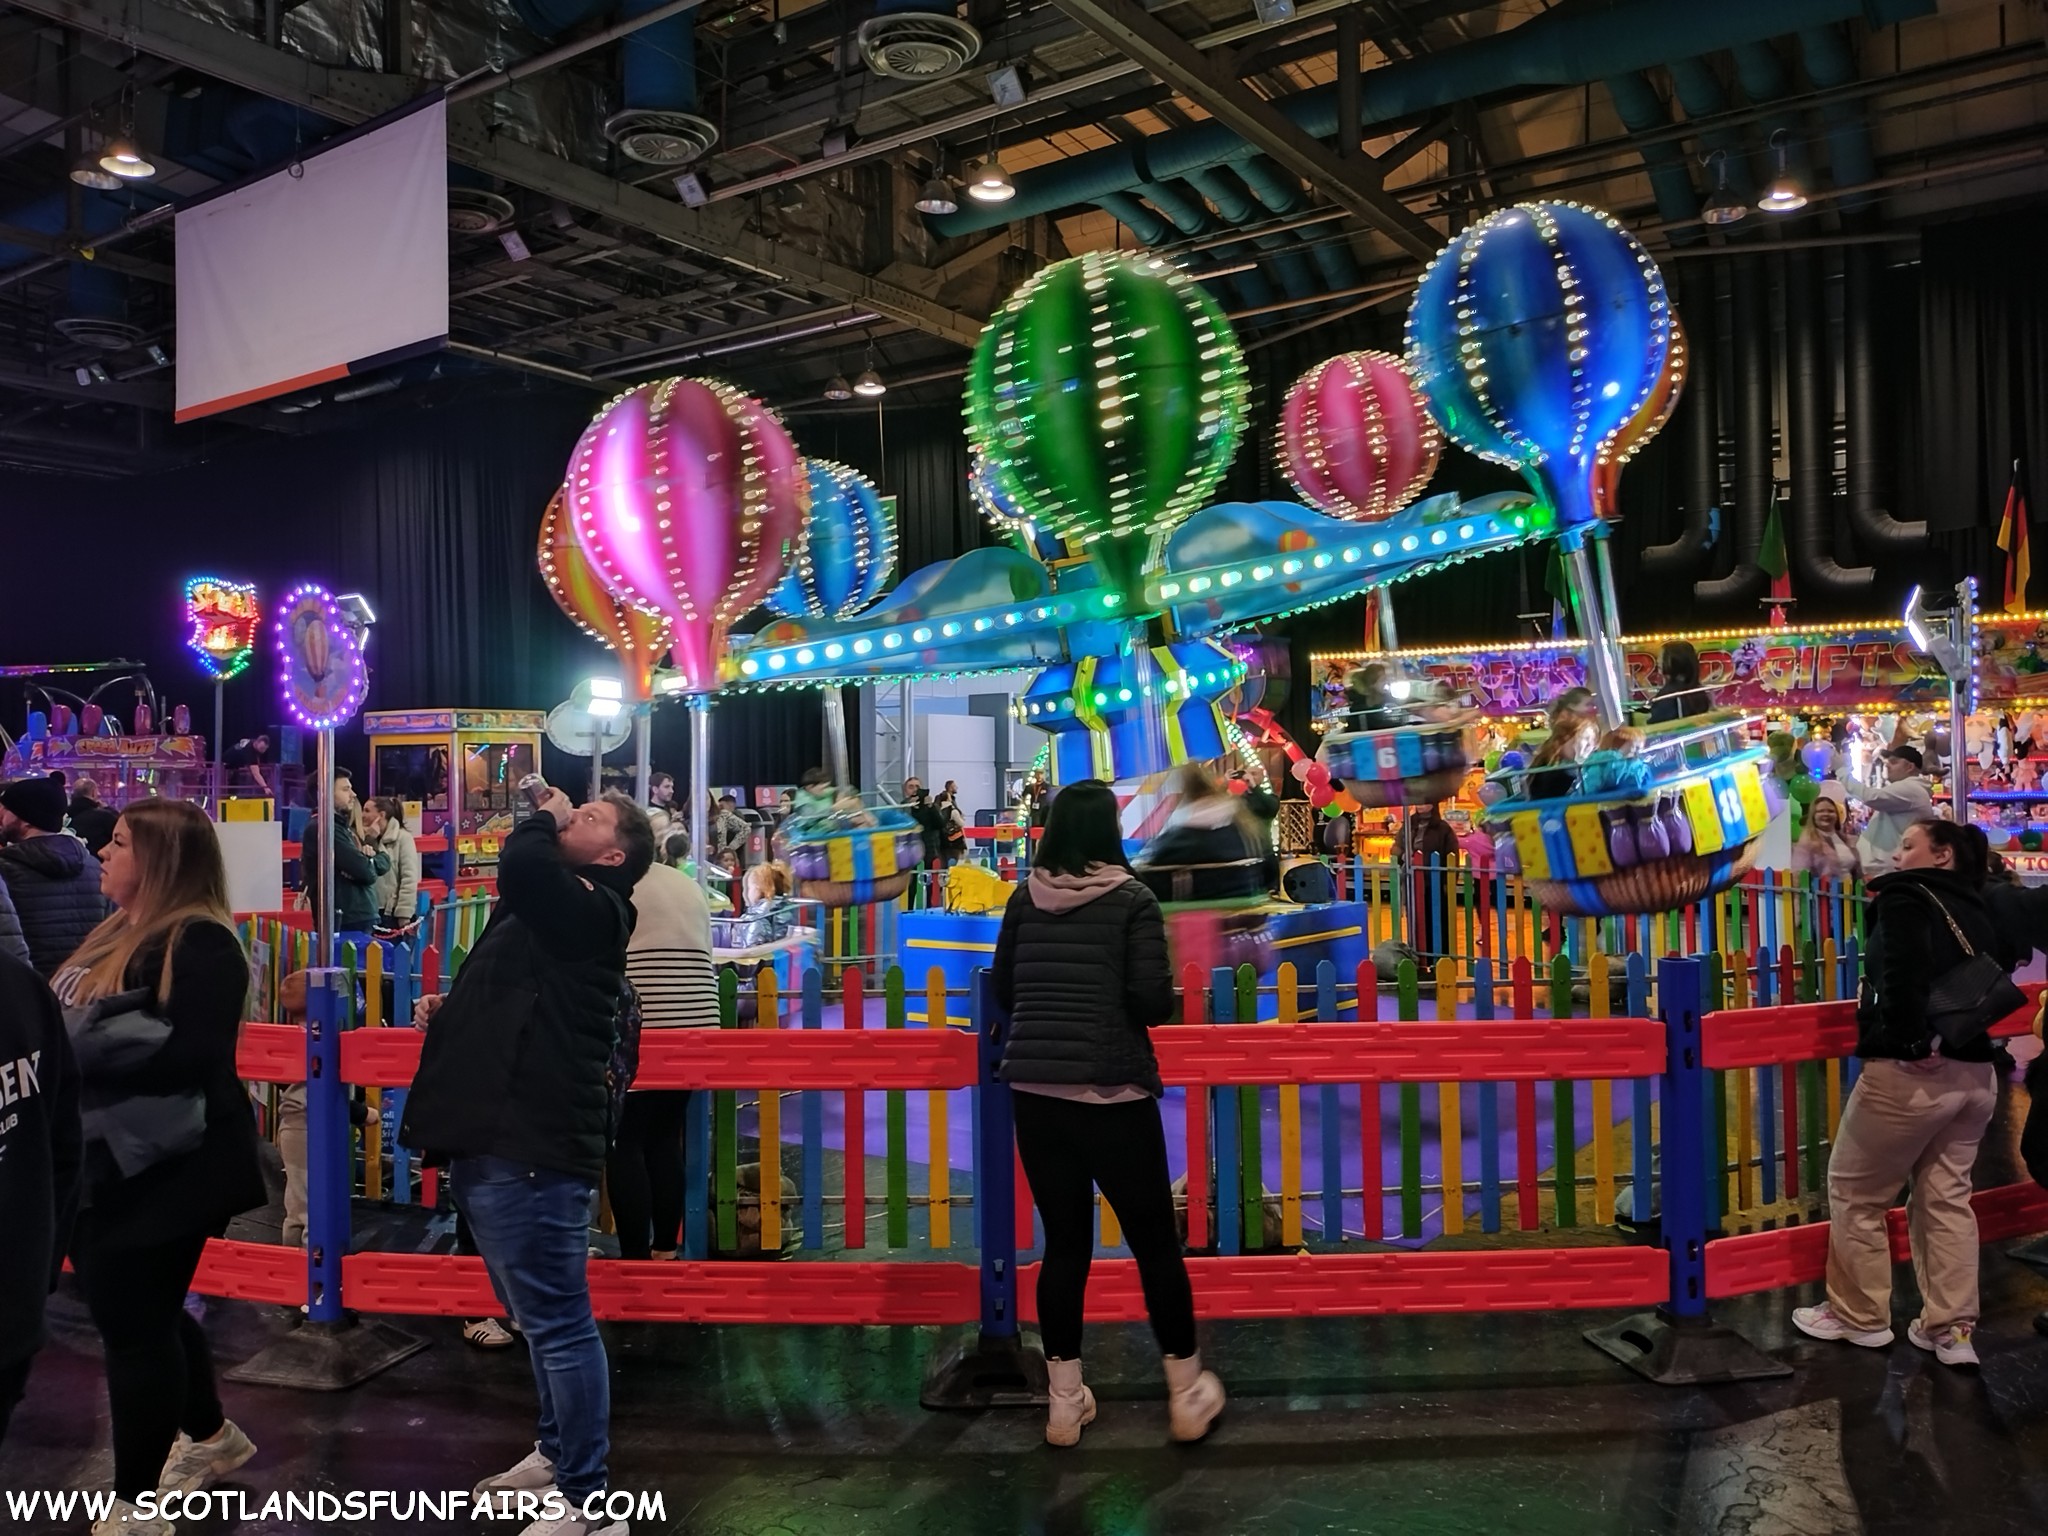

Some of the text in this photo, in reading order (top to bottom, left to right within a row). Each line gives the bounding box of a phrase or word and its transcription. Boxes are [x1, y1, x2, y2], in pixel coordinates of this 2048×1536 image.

[1757, 641, 1924, 693] GIFTS
[1377, 747, 1397, 769] 6
[1718, 787, 1742, 826] 8
